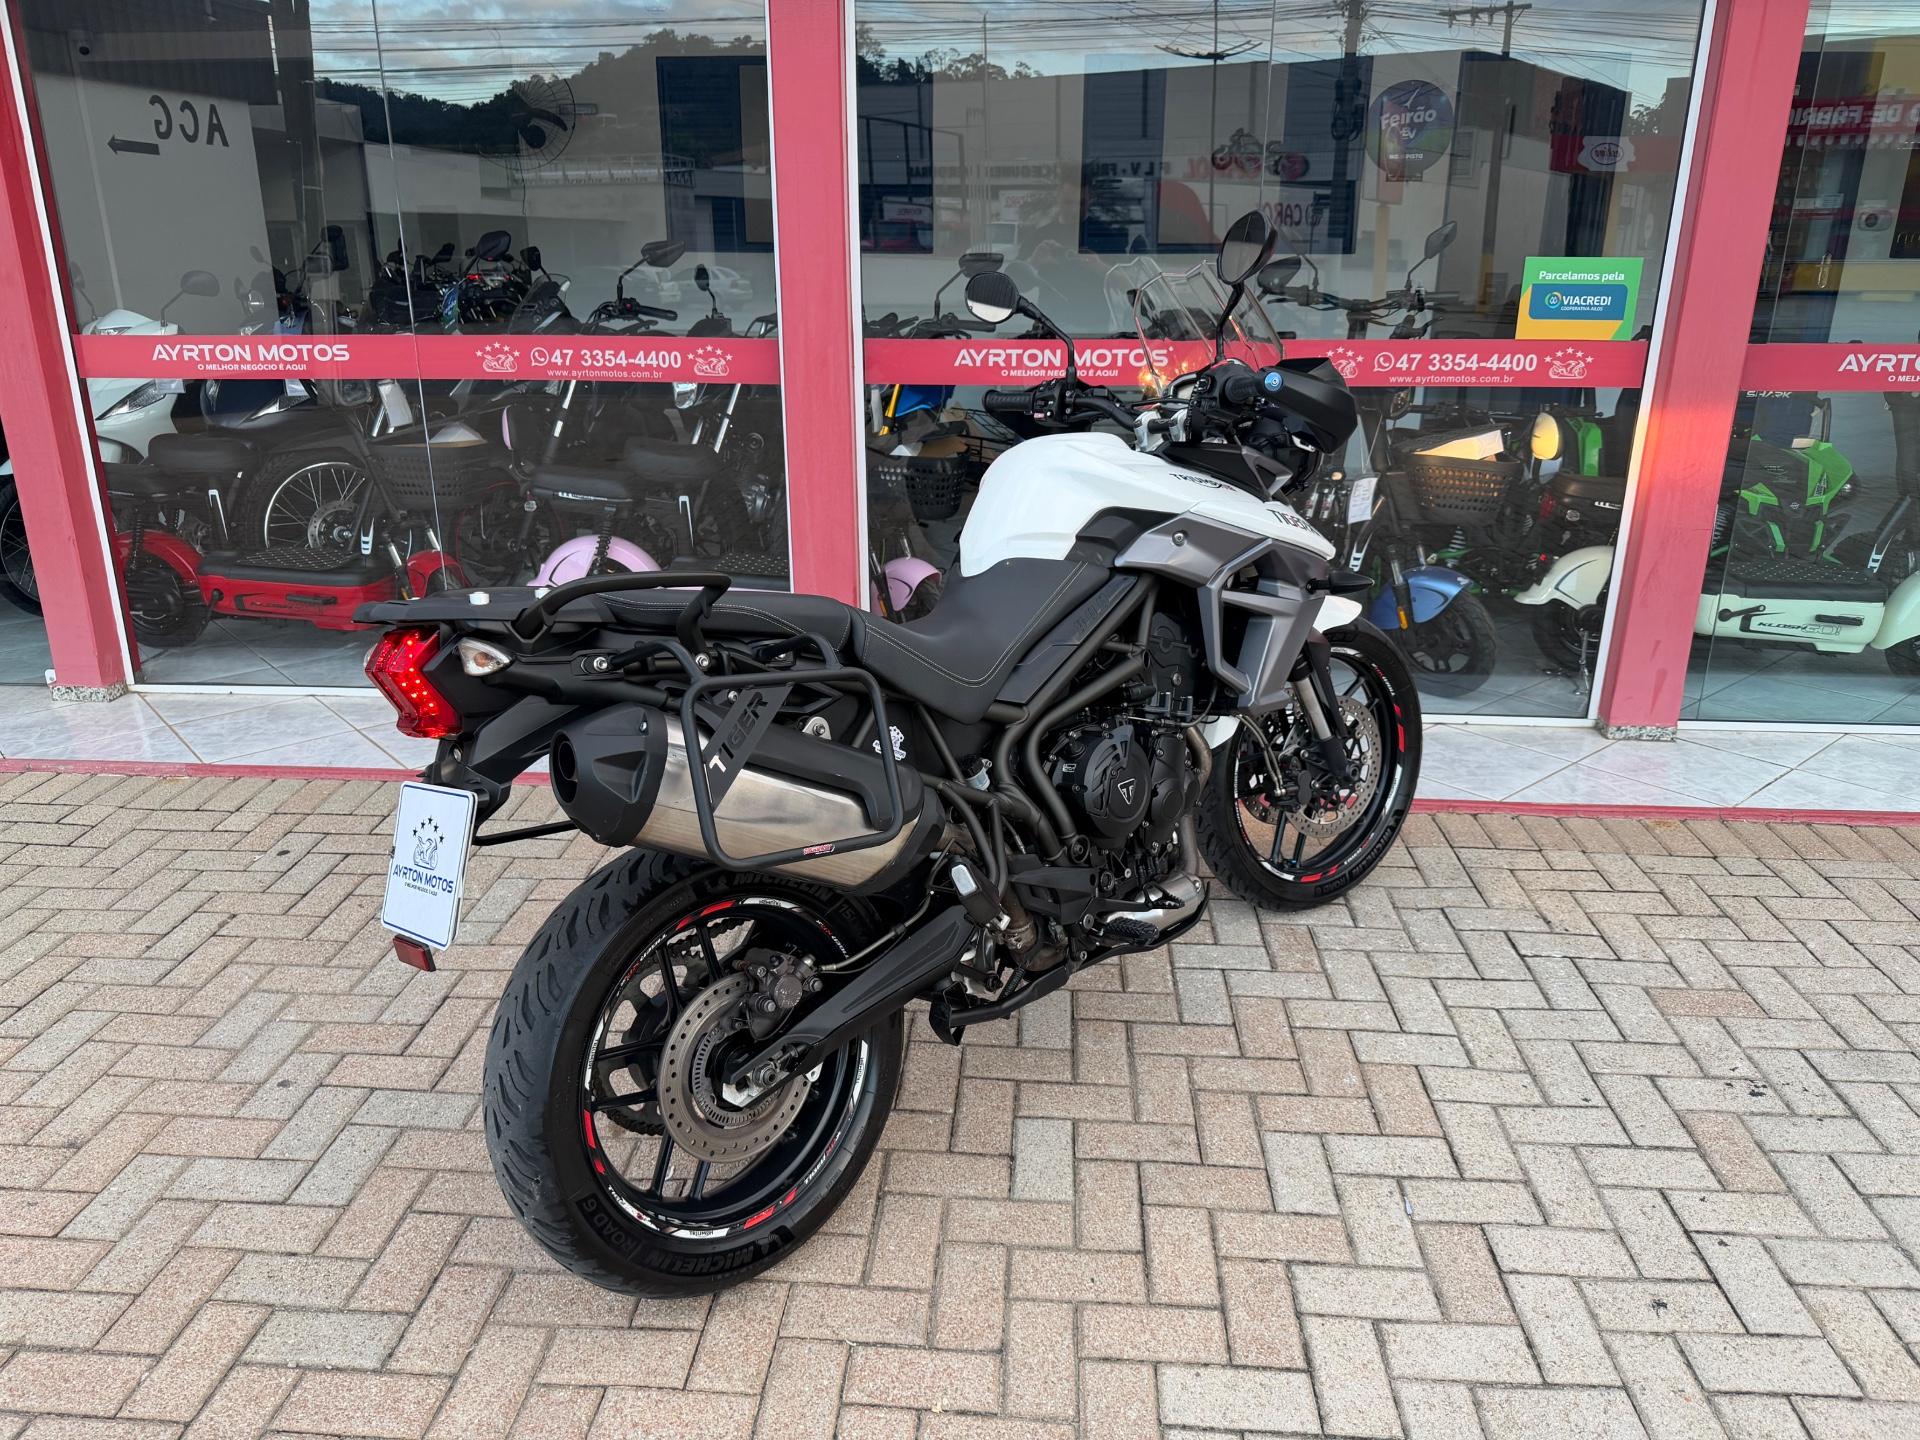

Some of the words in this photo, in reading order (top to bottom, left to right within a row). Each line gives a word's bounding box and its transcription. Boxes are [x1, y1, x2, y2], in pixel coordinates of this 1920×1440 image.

[1380, 106, 1437, 130] Feirão
[1539, 270, 1600, 281] Parcelamos
[1602, 271, 1625, 283] pela
[1562, 295, 1612, 306] VIACREDI
[152, 344, 251, 361] AYRTON
[258, 344, 350, 361] MOTOS
[551, 349, 574, 366] 47
[580, 350, 682, 369] 3354-4400
[953, 348, 1061, 367] AYRTON
[1073, 349, 1169, 367] MOTOS
[197, 363, 205, 371] O
[241, 362, 278, 371] NEGÓCIO
[279, 362, 285, 371] É
[1395, 353, 1421, 371] 47
[1427, 353, 1537, 372] 3354-4400
[546, 369, 663, 379] www.ayrtonmotos.com.br
[1001, 369, 1008, 377] O
[1010, 369, 1048, 377] MELHOR
[1050, 369, 1087, 377] NEGIO
[1088, 367, 1095, 377] É
[1096, 369, 1118, 377] AQUI
[1388, 374, 1515, 384] www.ayrtonmotos.com.br
[708, 690, 769, 773] TIGER
[392, 863, 424, 884] AYRTON
[424, 872, 454, 894] MOTOS
[593, 1210, 643, 1253] ROAD
[689, 1229, 715, 1238] TRIUMPH
[646, 1244, 755, 1274] MICHELIN
